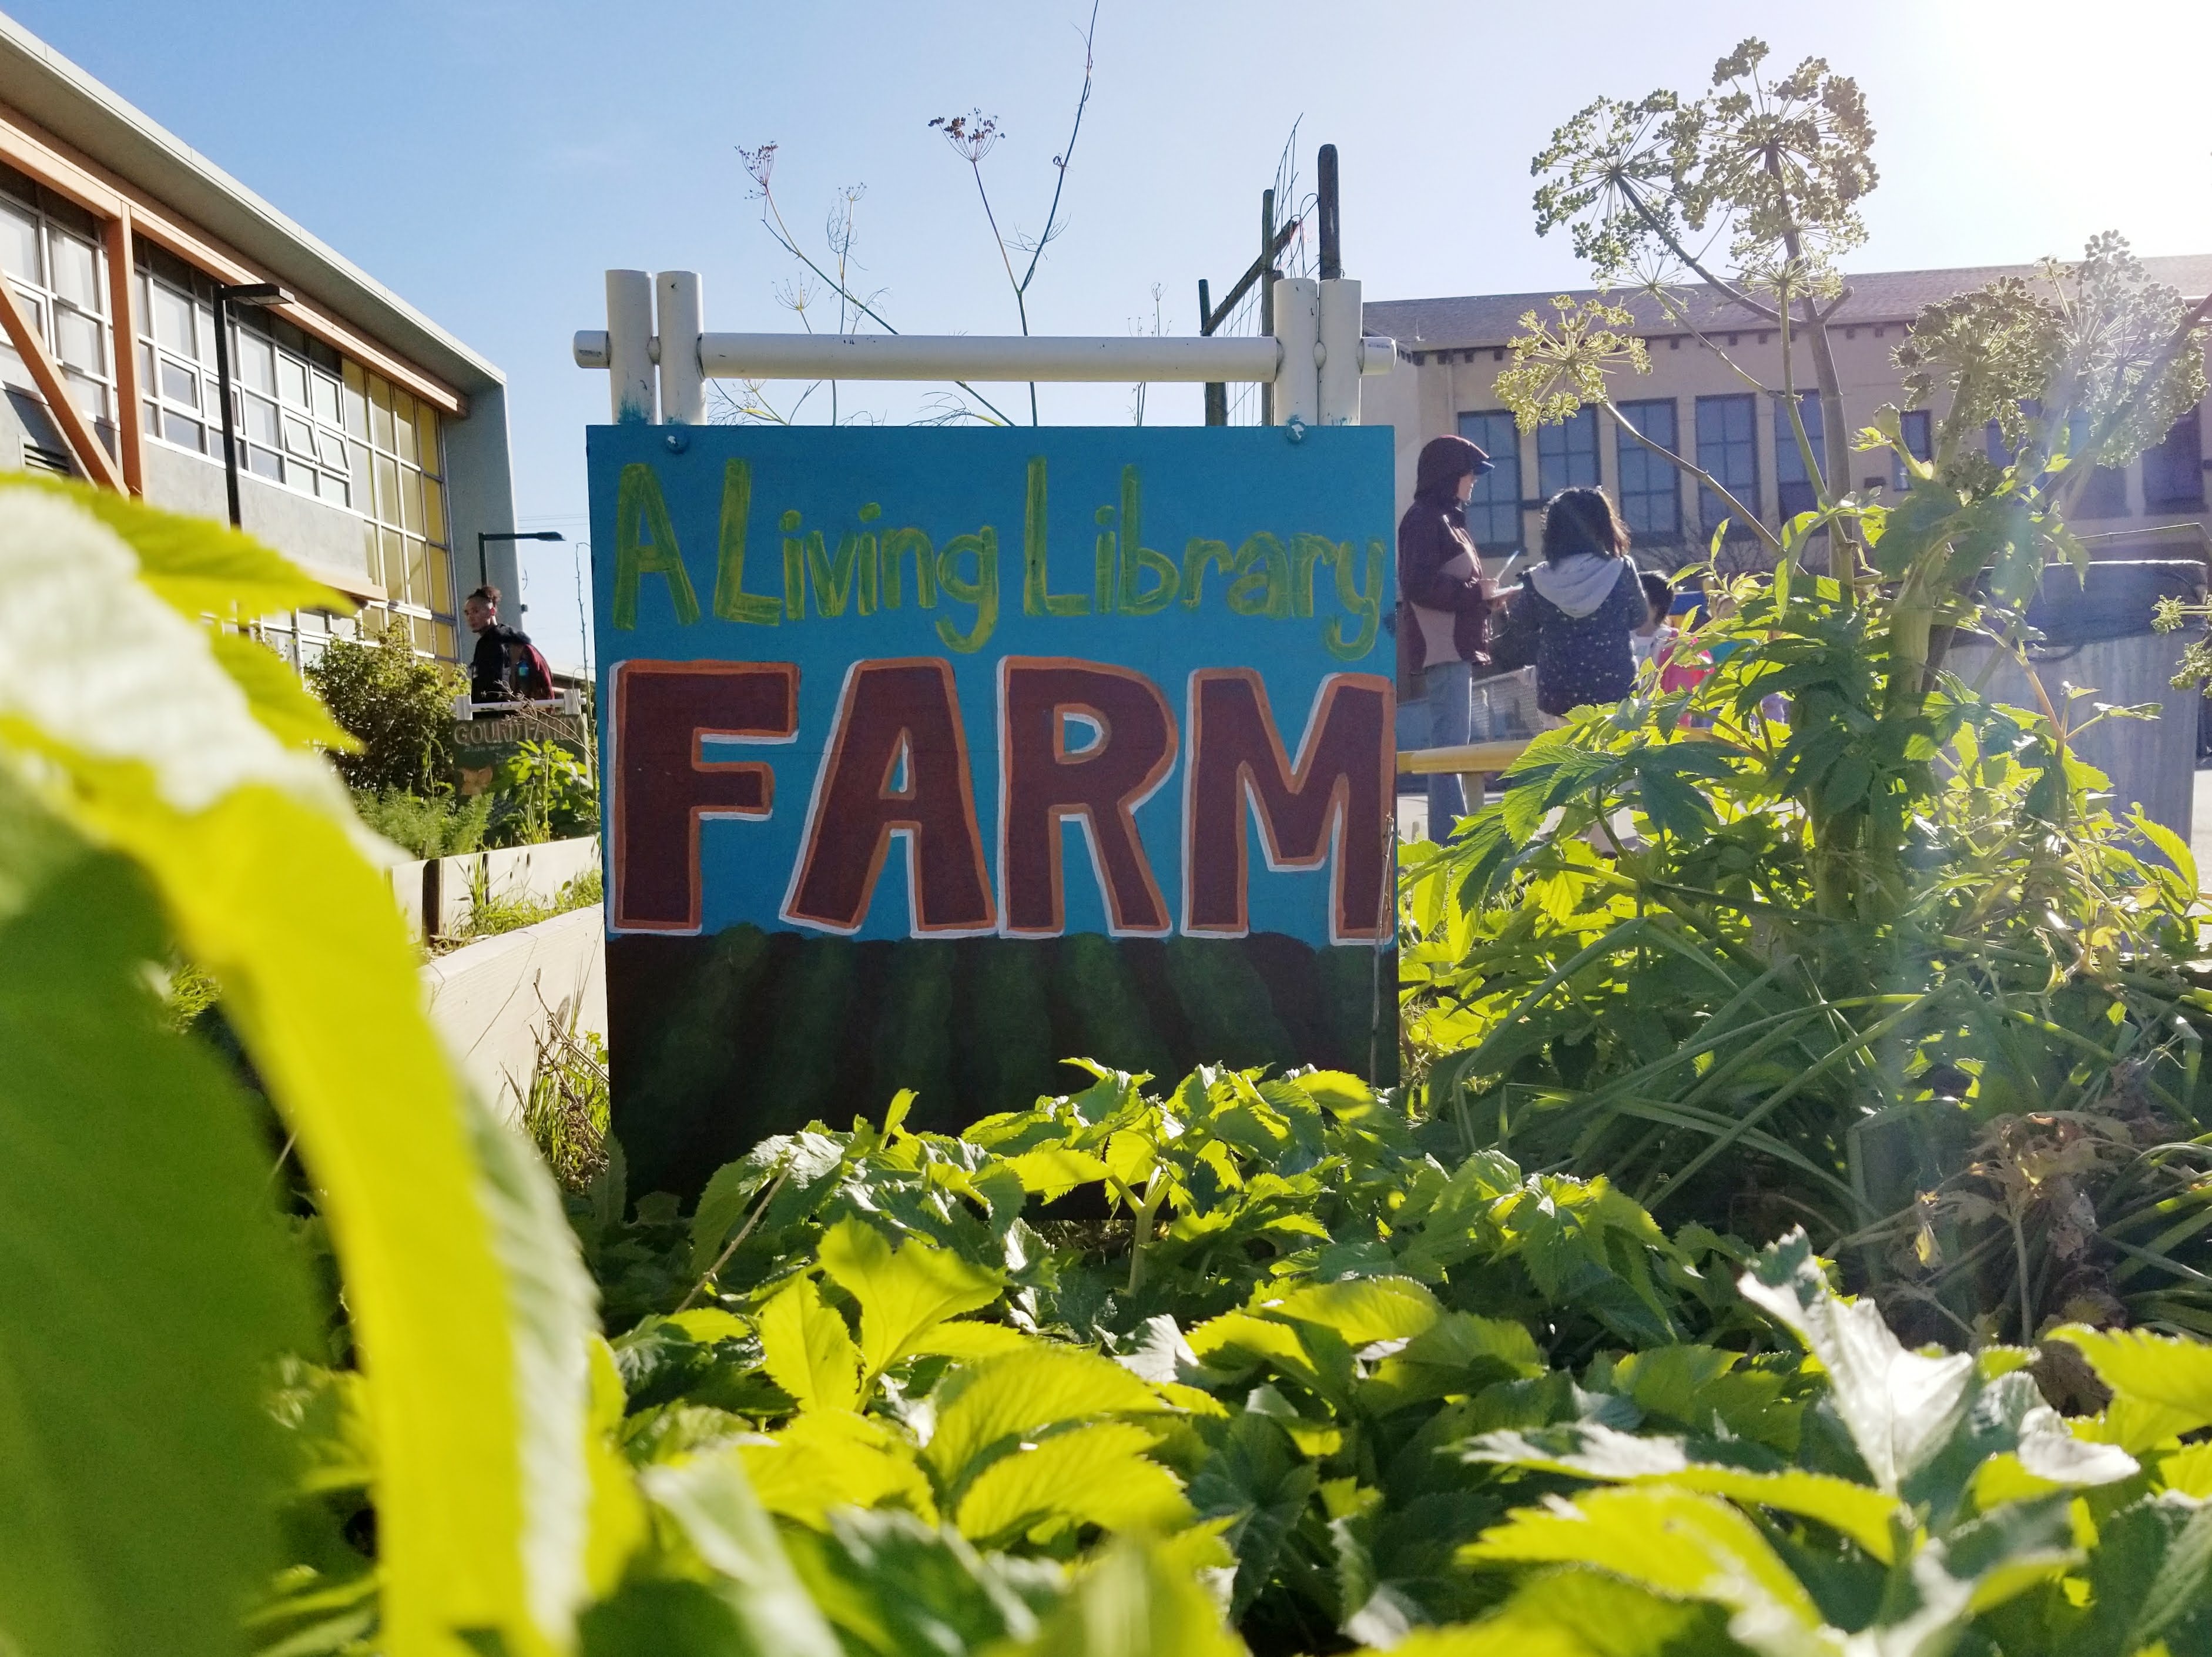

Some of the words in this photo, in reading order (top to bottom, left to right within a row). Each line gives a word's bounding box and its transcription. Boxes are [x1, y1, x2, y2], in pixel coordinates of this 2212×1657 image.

[613, 463, 700, 630] A
[713, 458, 998, 654] Living
[1024, 456, 1386, 661] Library
[454, 721, 521, 744] GOURD
[607, 655, 1393, 945] FARM
